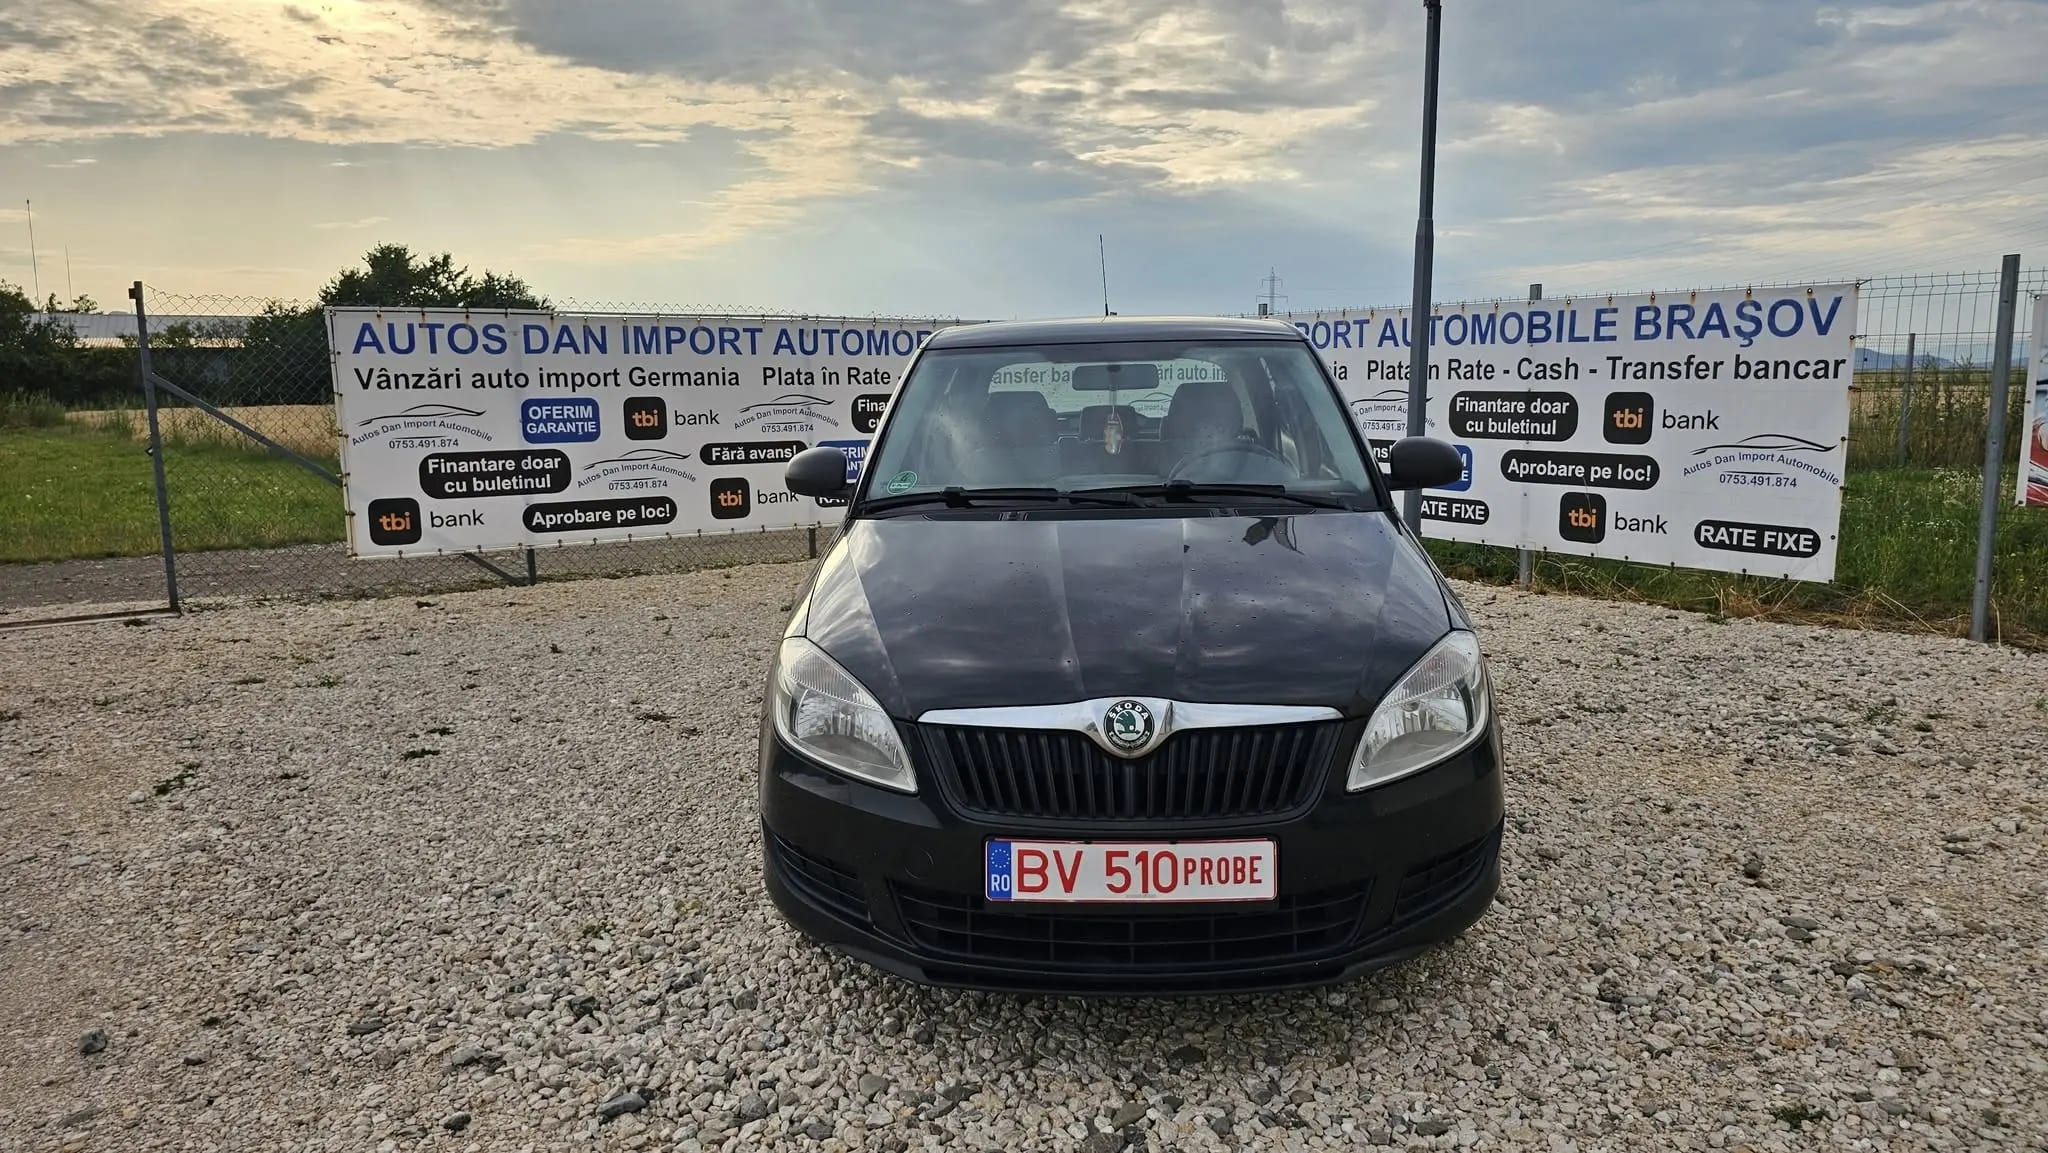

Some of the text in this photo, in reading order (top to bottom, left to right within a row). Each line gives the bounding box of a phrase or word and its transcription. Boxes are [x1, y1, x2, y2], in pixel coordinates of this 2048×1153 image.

[352, 321, 507, 355] AUTOS
[522, 324, 608, 356] DAN
[622, 325, 763, 356] IMPORT
[993, 367, 1048, 384] ansfer
[1177, 364, 1208, 380] auto
[1447, 359, 1496, 380] Rate
[1517, 357, 1579, 381] Cash
[1606, 354, 1725, 381] Transfer
[1733, 354, 1847, 381] bancar
[353, 366, 891, 392] Vânzări auto import Germania Plata în Rate
[528, 405, 593, 420] OFERIM
[1360, 407, 1373, 415] Dan
[1374, 404, 1396, 413] Import
[1456, 397, 1570, 415] Finantare doar
[632, 410, 720, 428] tbi bank
[733, 407, 839, 430] Autos Dan Import Automobile
[761, 423, 814, 433] 0753.491.874
[1466, 418, 1557, 435] cu buletinul
[1613, 408, 1720, 430] tbi bank
[352, 418, 493, 446] Autos Dan Import Automobile
[389, 438, 459, 449] 0753.491.874
[712, 445, 797, 461] Fără avans!
[427, 456, 561, 475] Finantare doar
[1508, 458, 1651, 481] Aprobare pe loc!
[1682, 452, 1839, 485] Autos Dan Import Automobile
[443, 474, 551, 493] cu buletinul
[577, 462, 697, 489] Autos Dan Import Automobile
[1719, 473, 1797, 488] 0753.491.874
[608, 480, 668, 491] 0753.491.874
[718, 489, 743, 507] tbi
[757, 489, 800, 505] bank
[378, 508, 485, 531] tbi bank
[532, 504, 670, 527] Aprobare pe loc!
[1420, 500, 1485, 521] ATE FIXE
[1569, 508, 1668, 535] tbi bank
[1700, 525, 1814, 553] RATE FIXE
[1017, 849, 1262, 894] BV 510 PROBE
[991, 874, 1010, 892] RO
